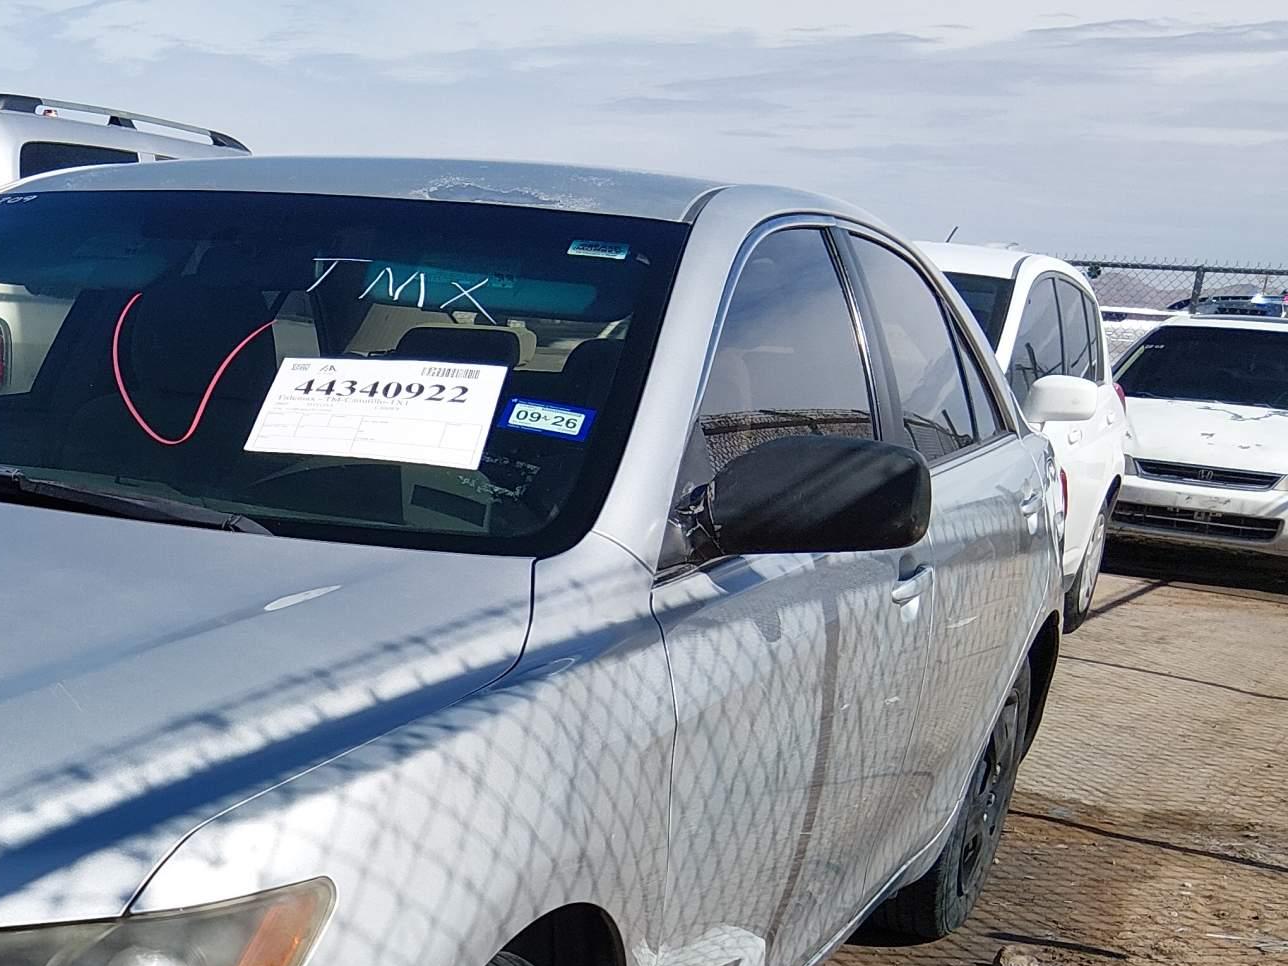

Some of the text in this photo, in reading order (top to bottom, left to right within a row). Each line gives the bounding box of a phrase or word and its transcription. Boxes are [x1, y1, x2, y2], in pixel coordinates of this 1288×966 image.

[306, 258, 497, 325] TMX
[294, 378, 470, 404] 44340922
[515, 409, 578, 429] 09 26
